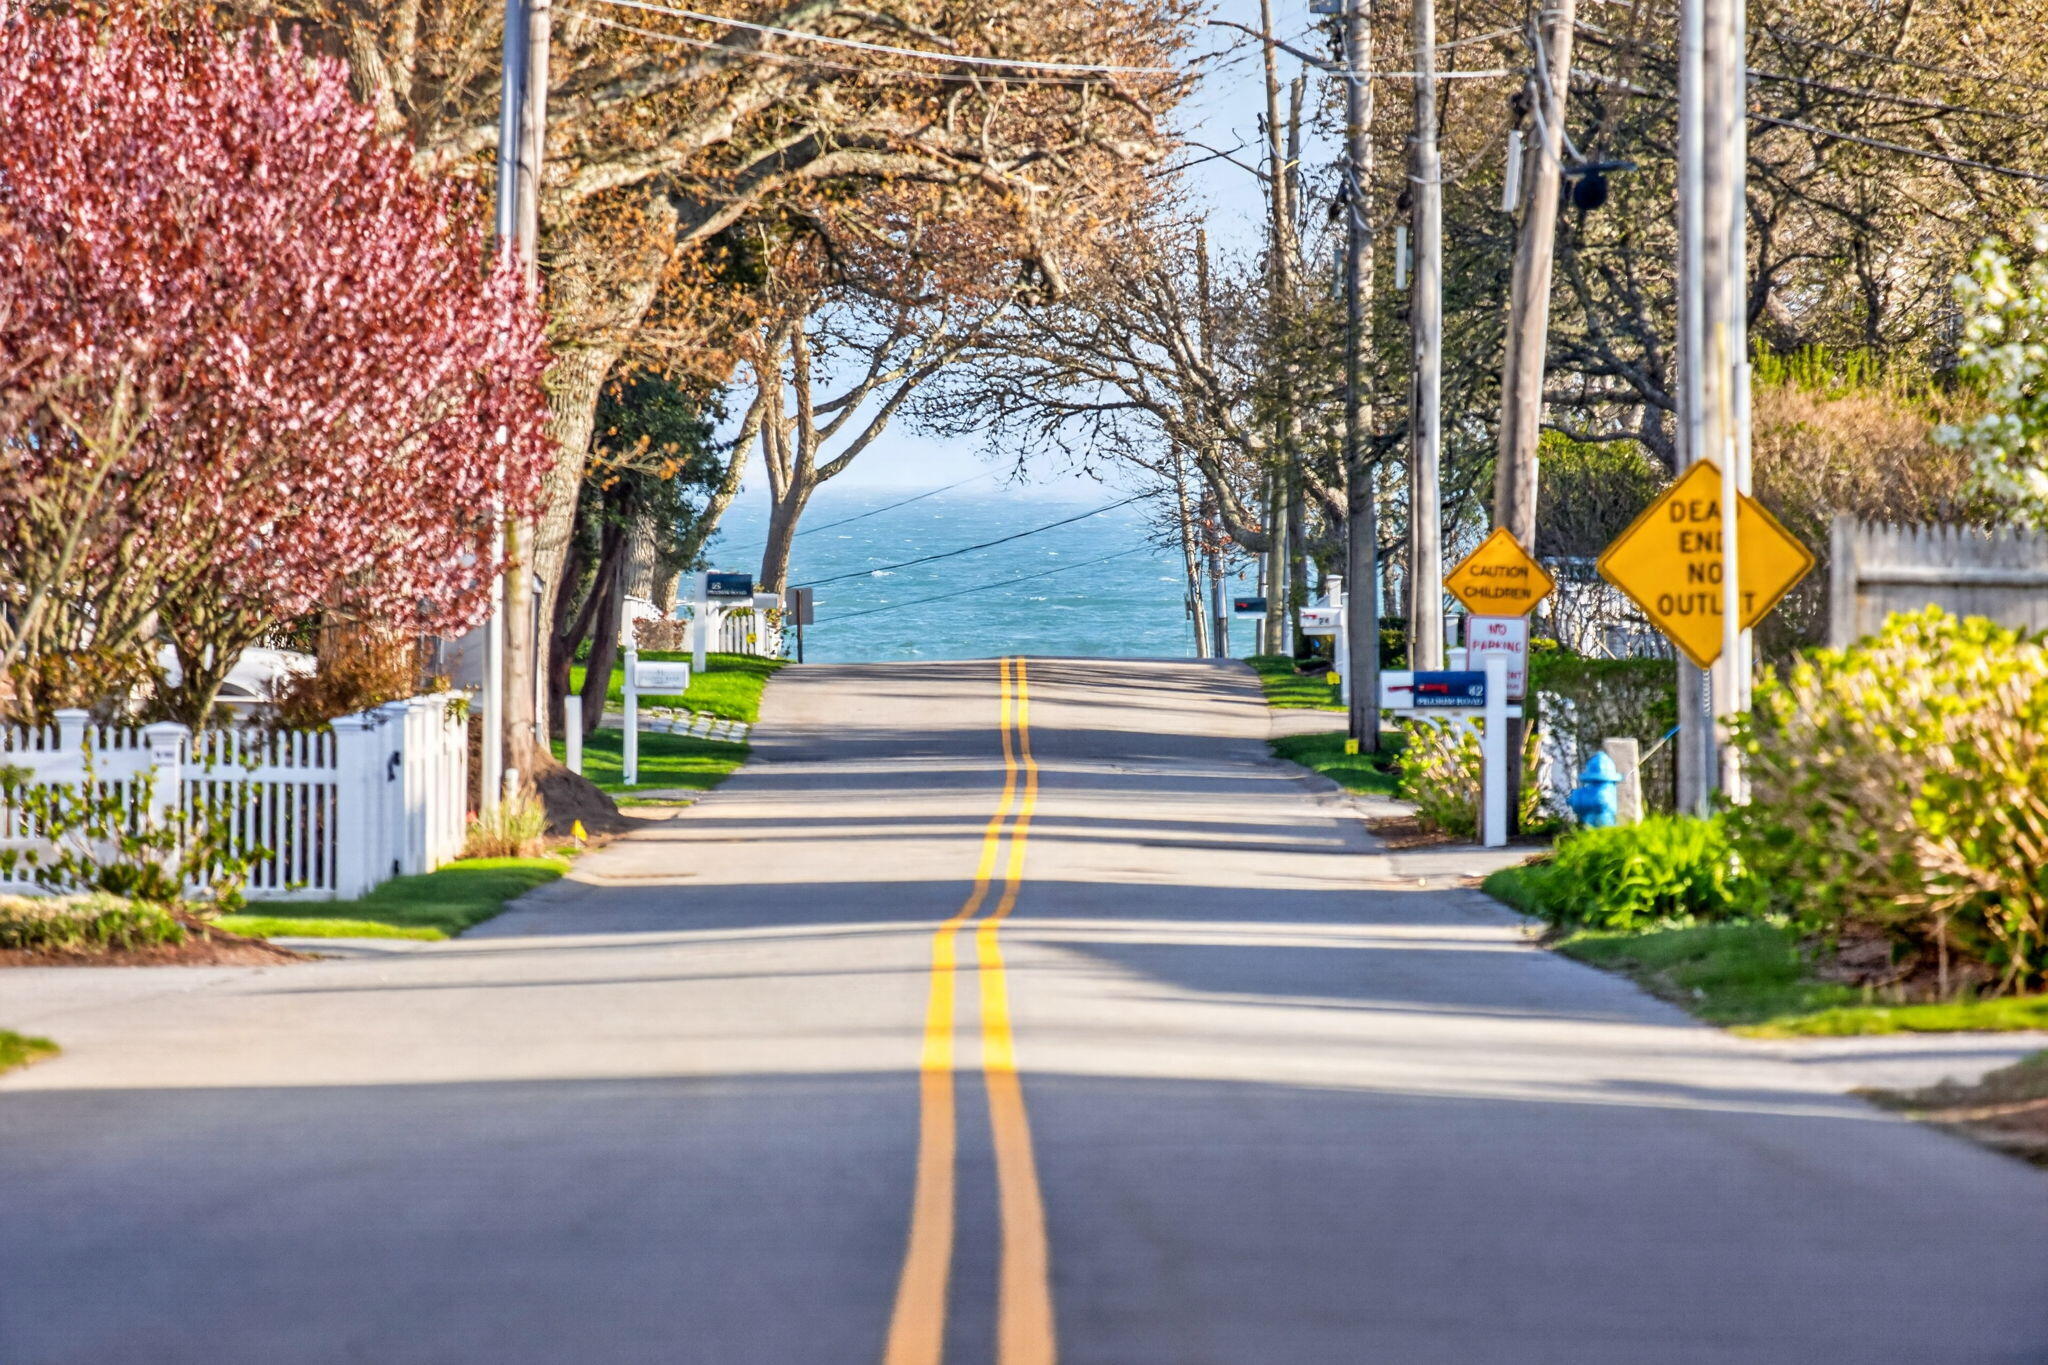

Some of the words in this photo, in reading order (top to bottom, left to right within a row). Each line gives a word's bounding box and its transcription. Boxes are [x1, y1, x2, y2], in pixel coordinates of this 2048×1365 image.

[1469, 565, 1528, 578] CAUTION
[1688, 562, 1724, 584] NO
[1463, 586, 1532, 599] CHILDREN
[1657, 592, 1757, 616] OUTLT
[1488, 623, 1507, 636] NO
